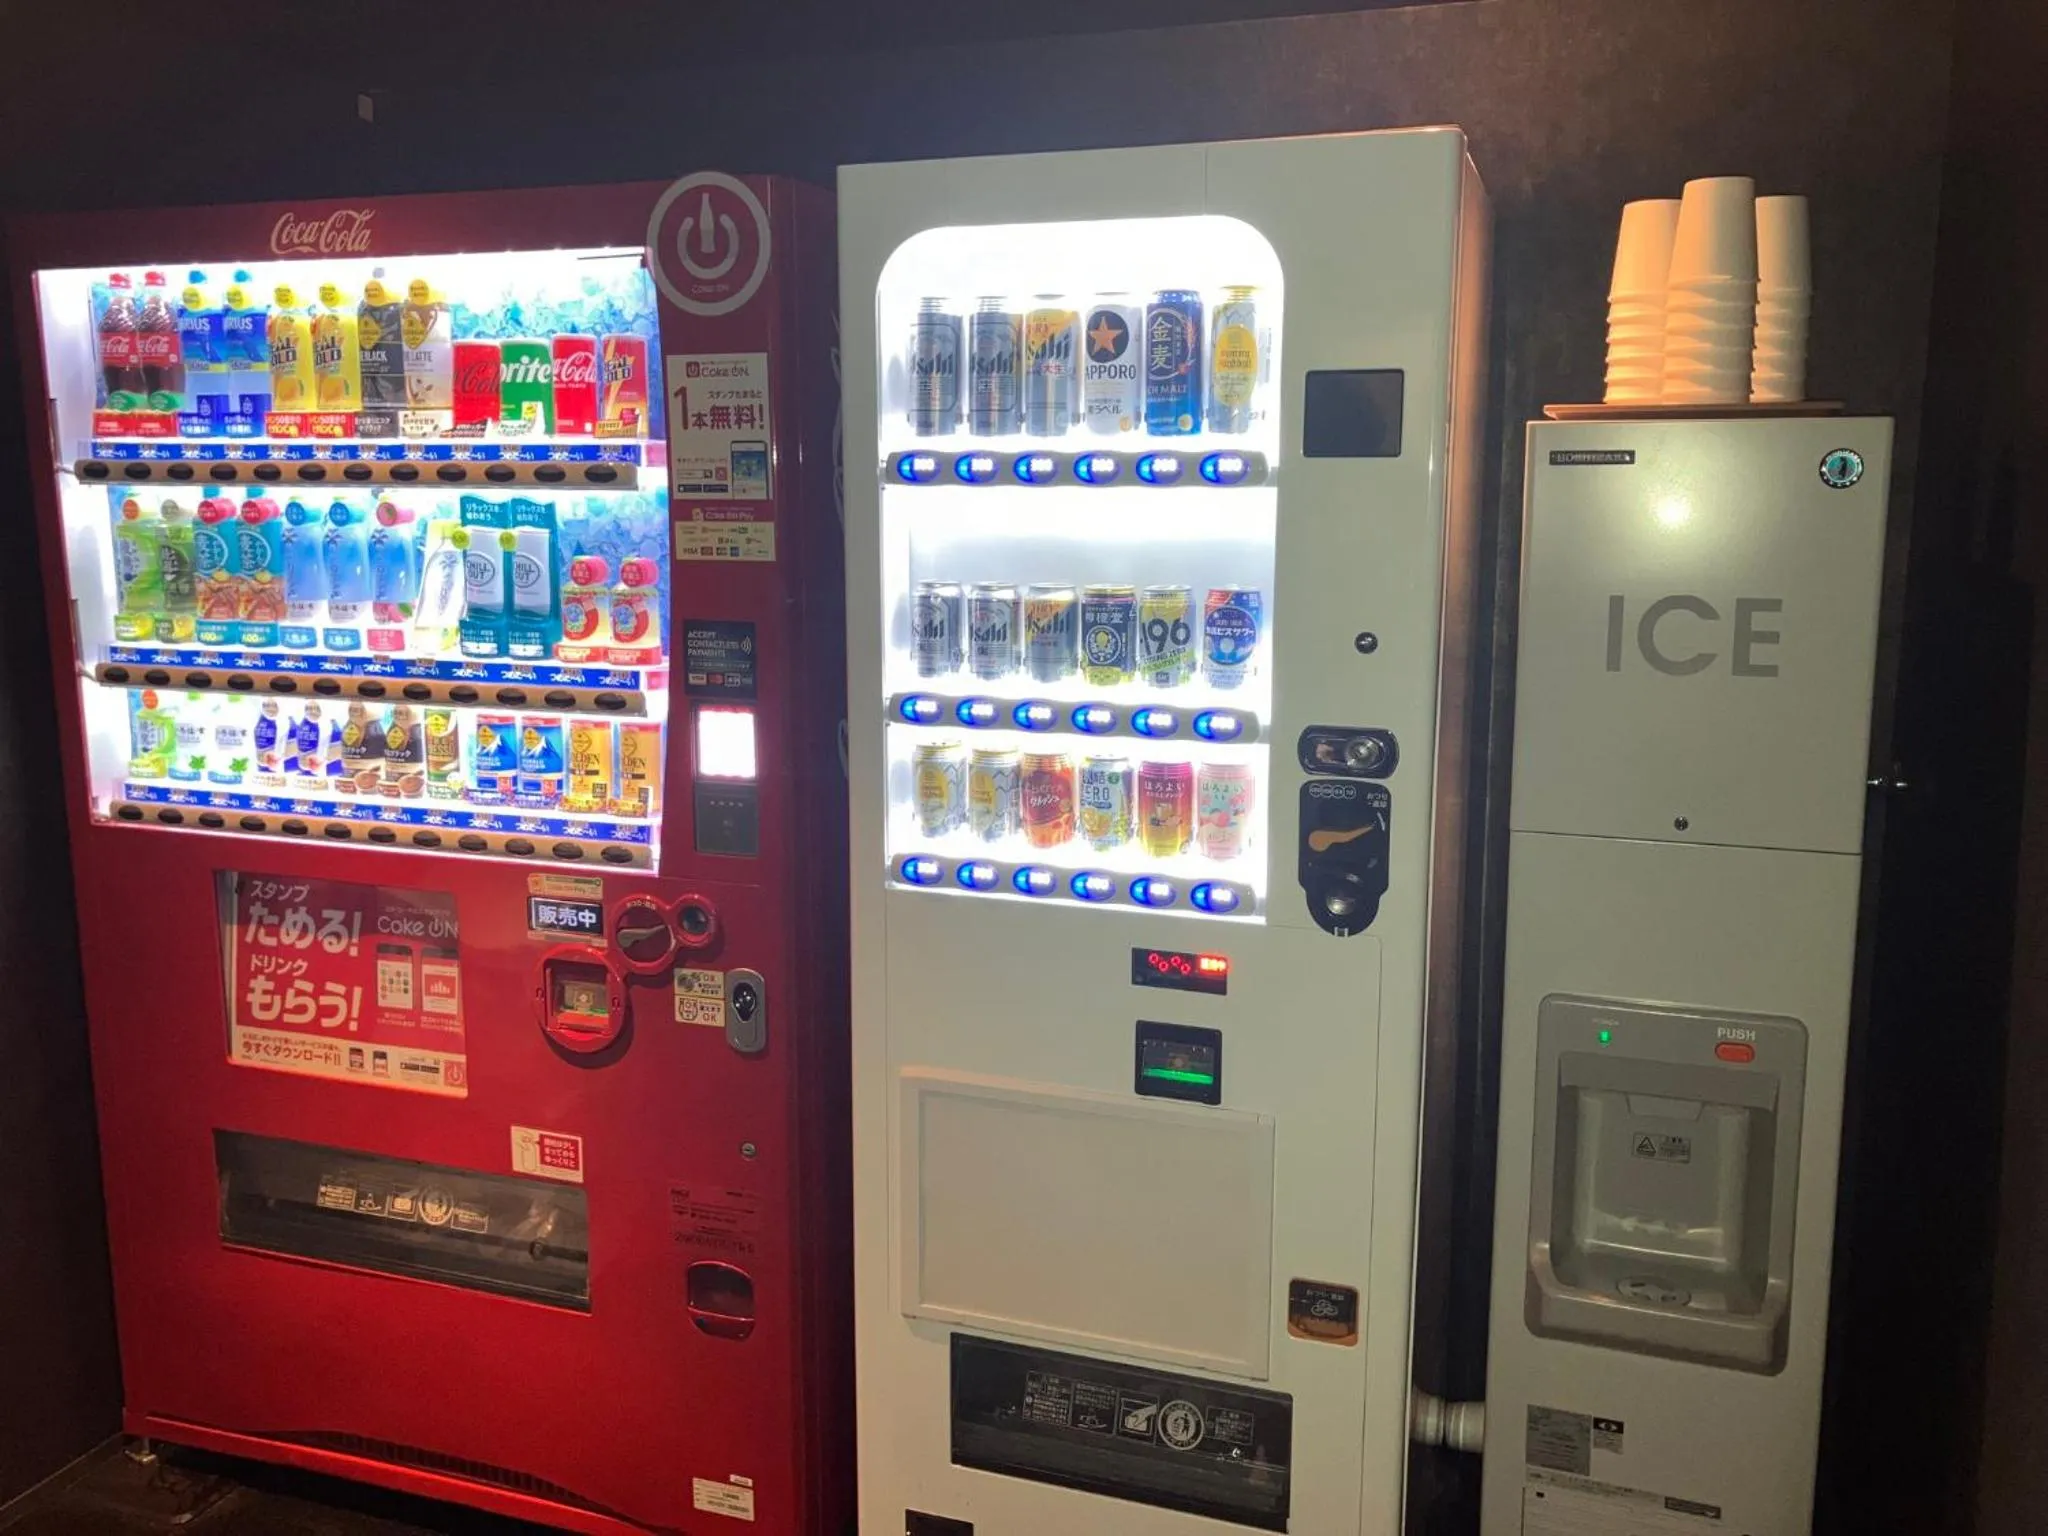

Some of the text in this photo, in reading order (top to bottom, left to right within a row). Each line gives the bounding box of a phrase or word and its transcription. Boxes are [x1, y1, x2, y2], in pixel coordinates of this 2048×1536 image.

[271, 208, 375, 254] Coca-Cola
[1151, 317, 1172, 371] 金麦
[1085, 364, 1136, 381] APPORO
[1606, 594, 1783, 677] ICE
[250, 879, 310, 901] スタンプ
[377, 915, 459, 939] Coke ON
[538, 905, 597, 928] 販売中
[250, 954, 309, 976] ドリンク
[1716, 1026, 1757, 1042] PUSH
